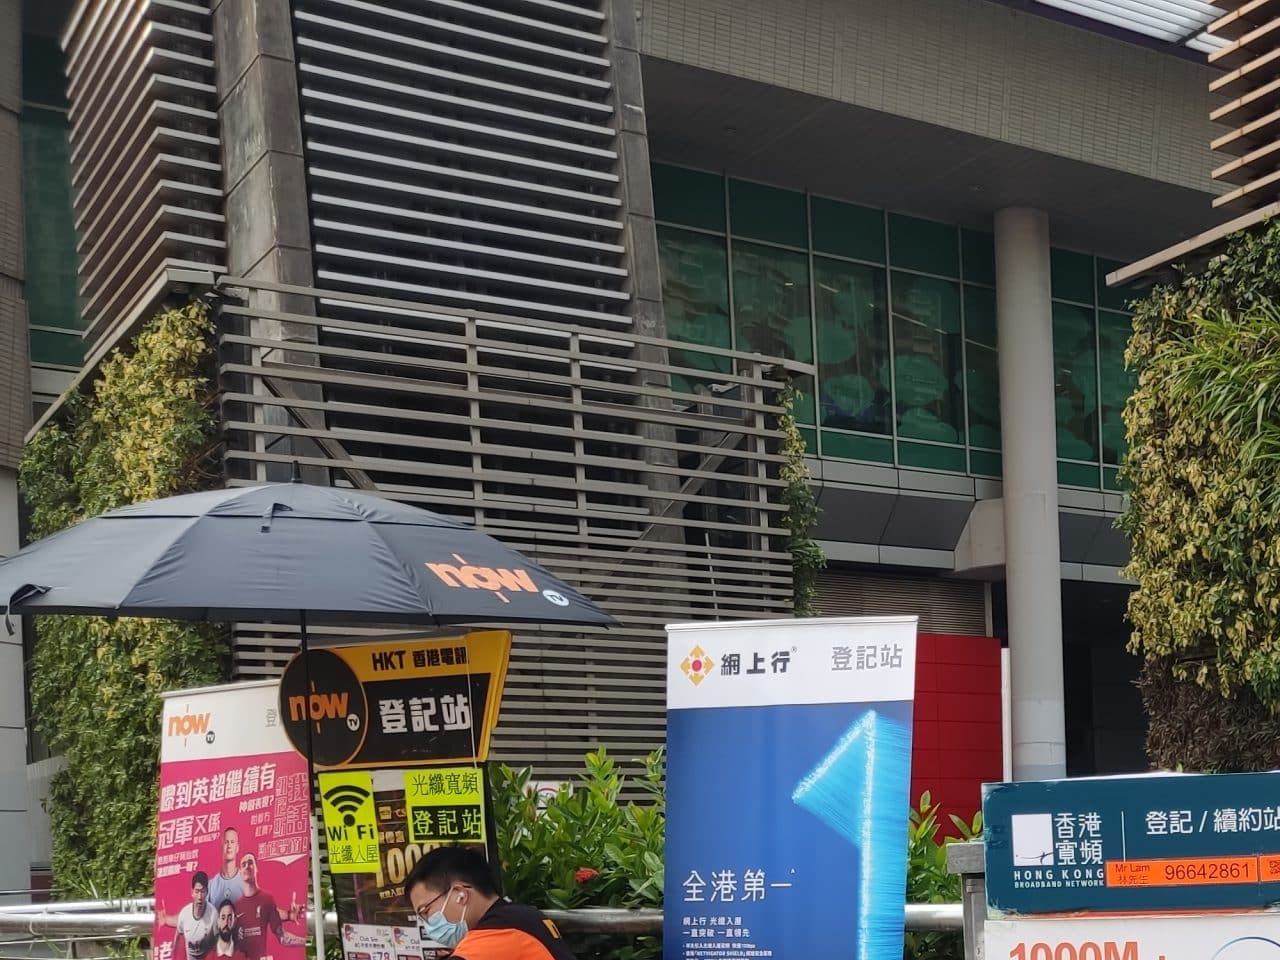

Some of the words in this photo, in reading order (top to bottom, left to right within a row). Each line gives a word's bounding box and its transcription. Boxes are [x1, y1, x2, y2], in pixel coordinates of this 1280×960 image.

[372, 650, 405, 671] HKT
[413, 646, 467, 667] 香港電訊
[720, 650, 790, 676] 網上行
[831, 643, 903, 671] 登記站
[379, 694, 471, 734] 登記站
[411, 772, 479, 796] 光纖寬頻
[414, 808, 481, 836] 登記站
[1055, 812, 1101, 839] 香港
[1056, 840, 1103, 865] 寬頻
[1014, 870, 1053, 880] HONG
[1062, 868, 1104, 879] KONG
[1115, 864, 1127, 873] Mr
[1130, 864, 1149, 872] Lam
[1165, 864, 1249, 880] 96642861
[1065, 879, 1105, 887] NETWORK
